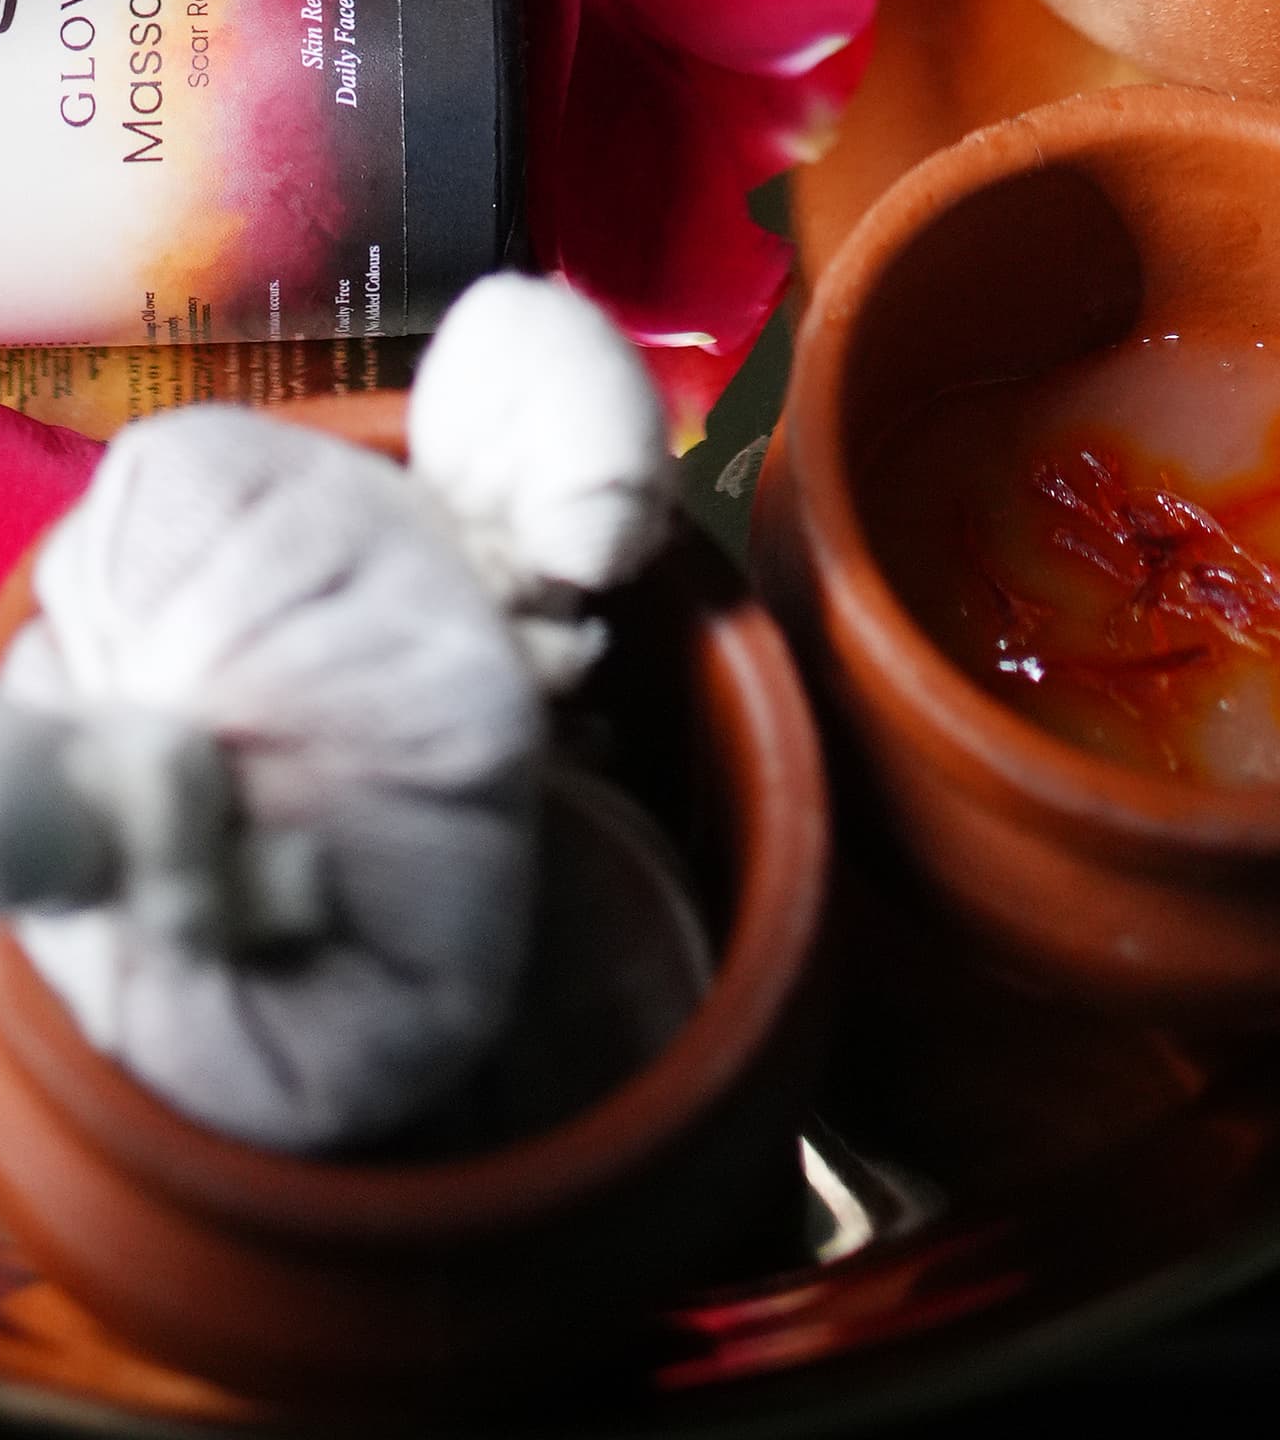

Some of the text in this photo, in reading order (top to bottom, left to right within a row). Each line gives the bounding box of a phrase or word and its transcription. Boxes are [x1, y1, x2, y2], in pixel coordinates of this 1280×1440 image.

[187, 25, 210, 89] Scar
[300, 26, 324, 70] Skin
[333, 48, 362, 109] Daily
[269, 279, 281, 312] occurs.
[334, 278, 355, 333] Cruelty Free
[364, 244, 381, 332] No Added Colours
